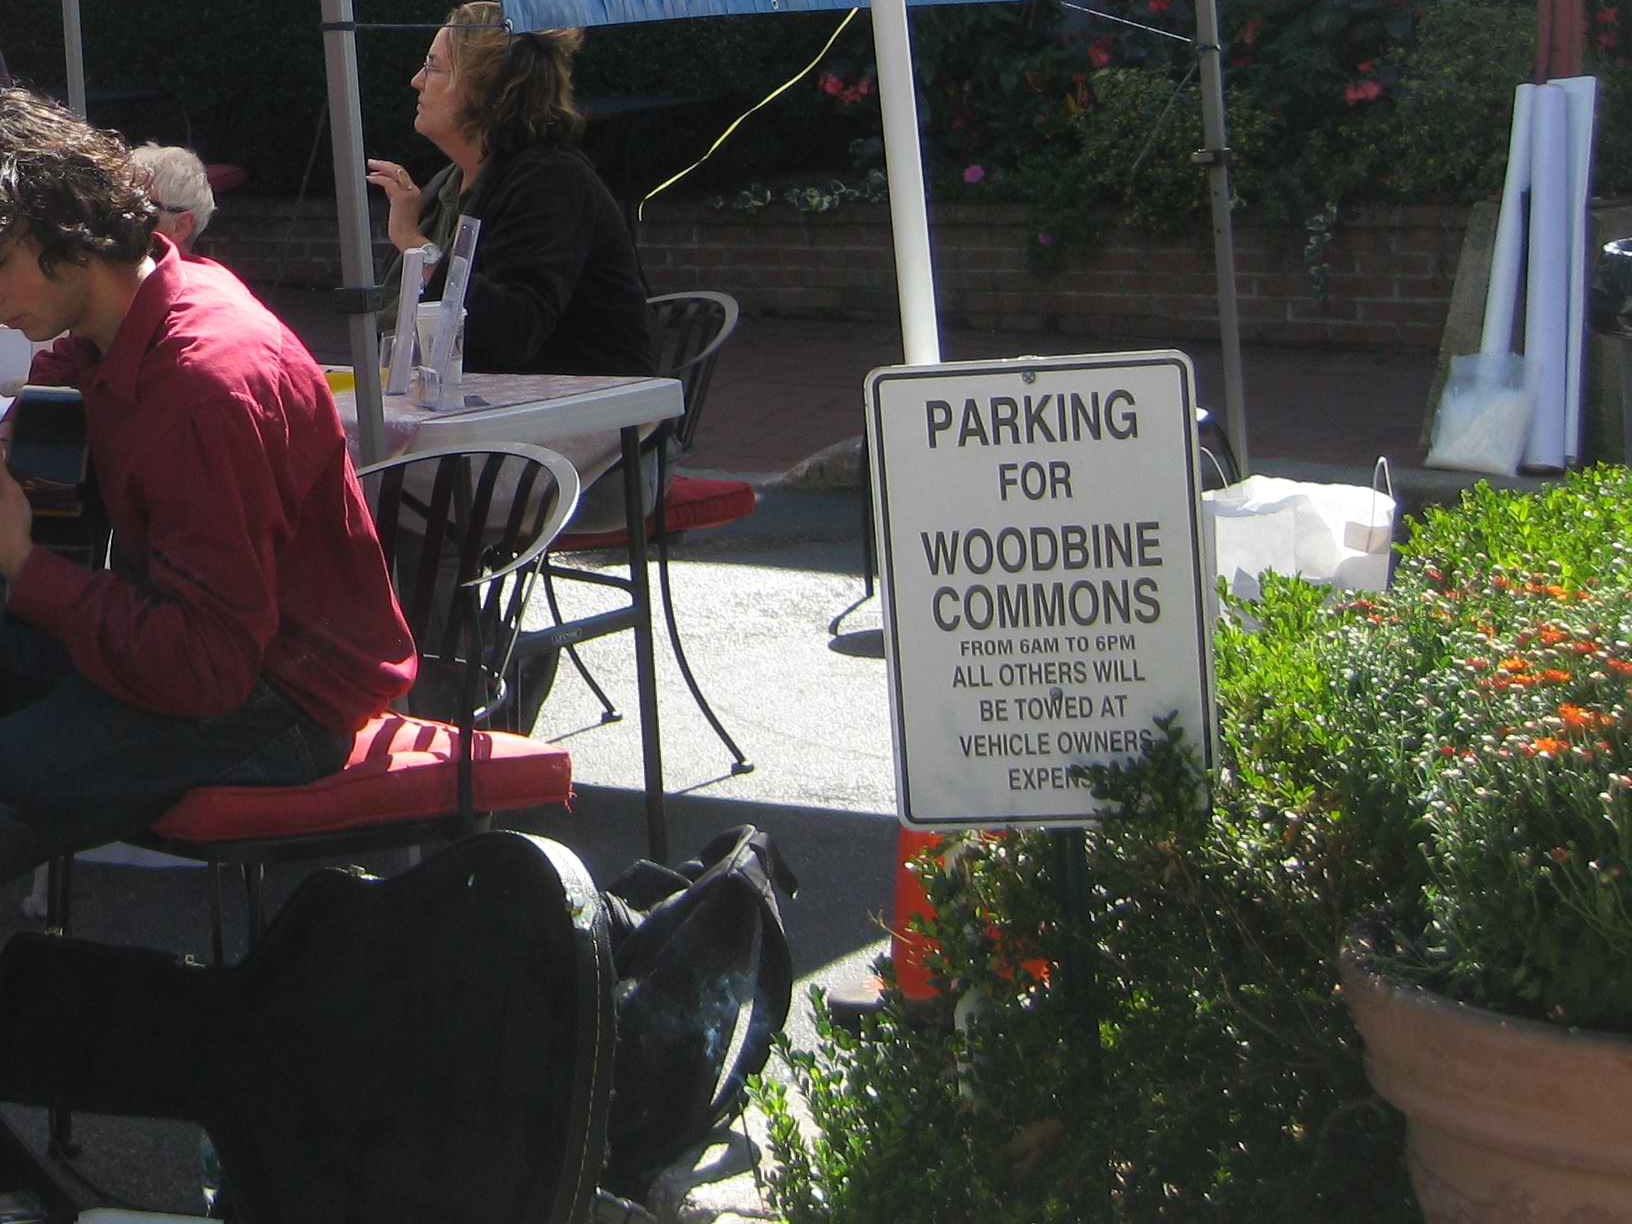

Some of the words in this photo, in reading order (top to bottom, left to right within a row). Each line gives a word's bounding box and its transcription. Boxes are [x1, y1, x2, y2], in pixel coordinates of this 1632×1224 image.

[925, 389, 1139, 449] PARKING
[997, 460, 1073, 501] FOR
[920, 521, 1164, 576] WOODBINE
[931, 576, 1162, 632] COMMONS
[960, 638, 1014, 657] FROM
[1019, 637, 1060, 655] 6AM
[1065, 636, 1090, 653] TO
[1095, 634, 1136, 652] 6PM
[951, 664, 993, 689] ALL
[998, 660, 1088, 686] OTHERS
[1092, 659, 1146, 683] WILL
[979, 698, 1008, 723] BE
[1014, 695, 1093, 721] TOWED
[1099, 694, 1128, 719] AT
[958, 730, 1051, 758] VEHICLE
